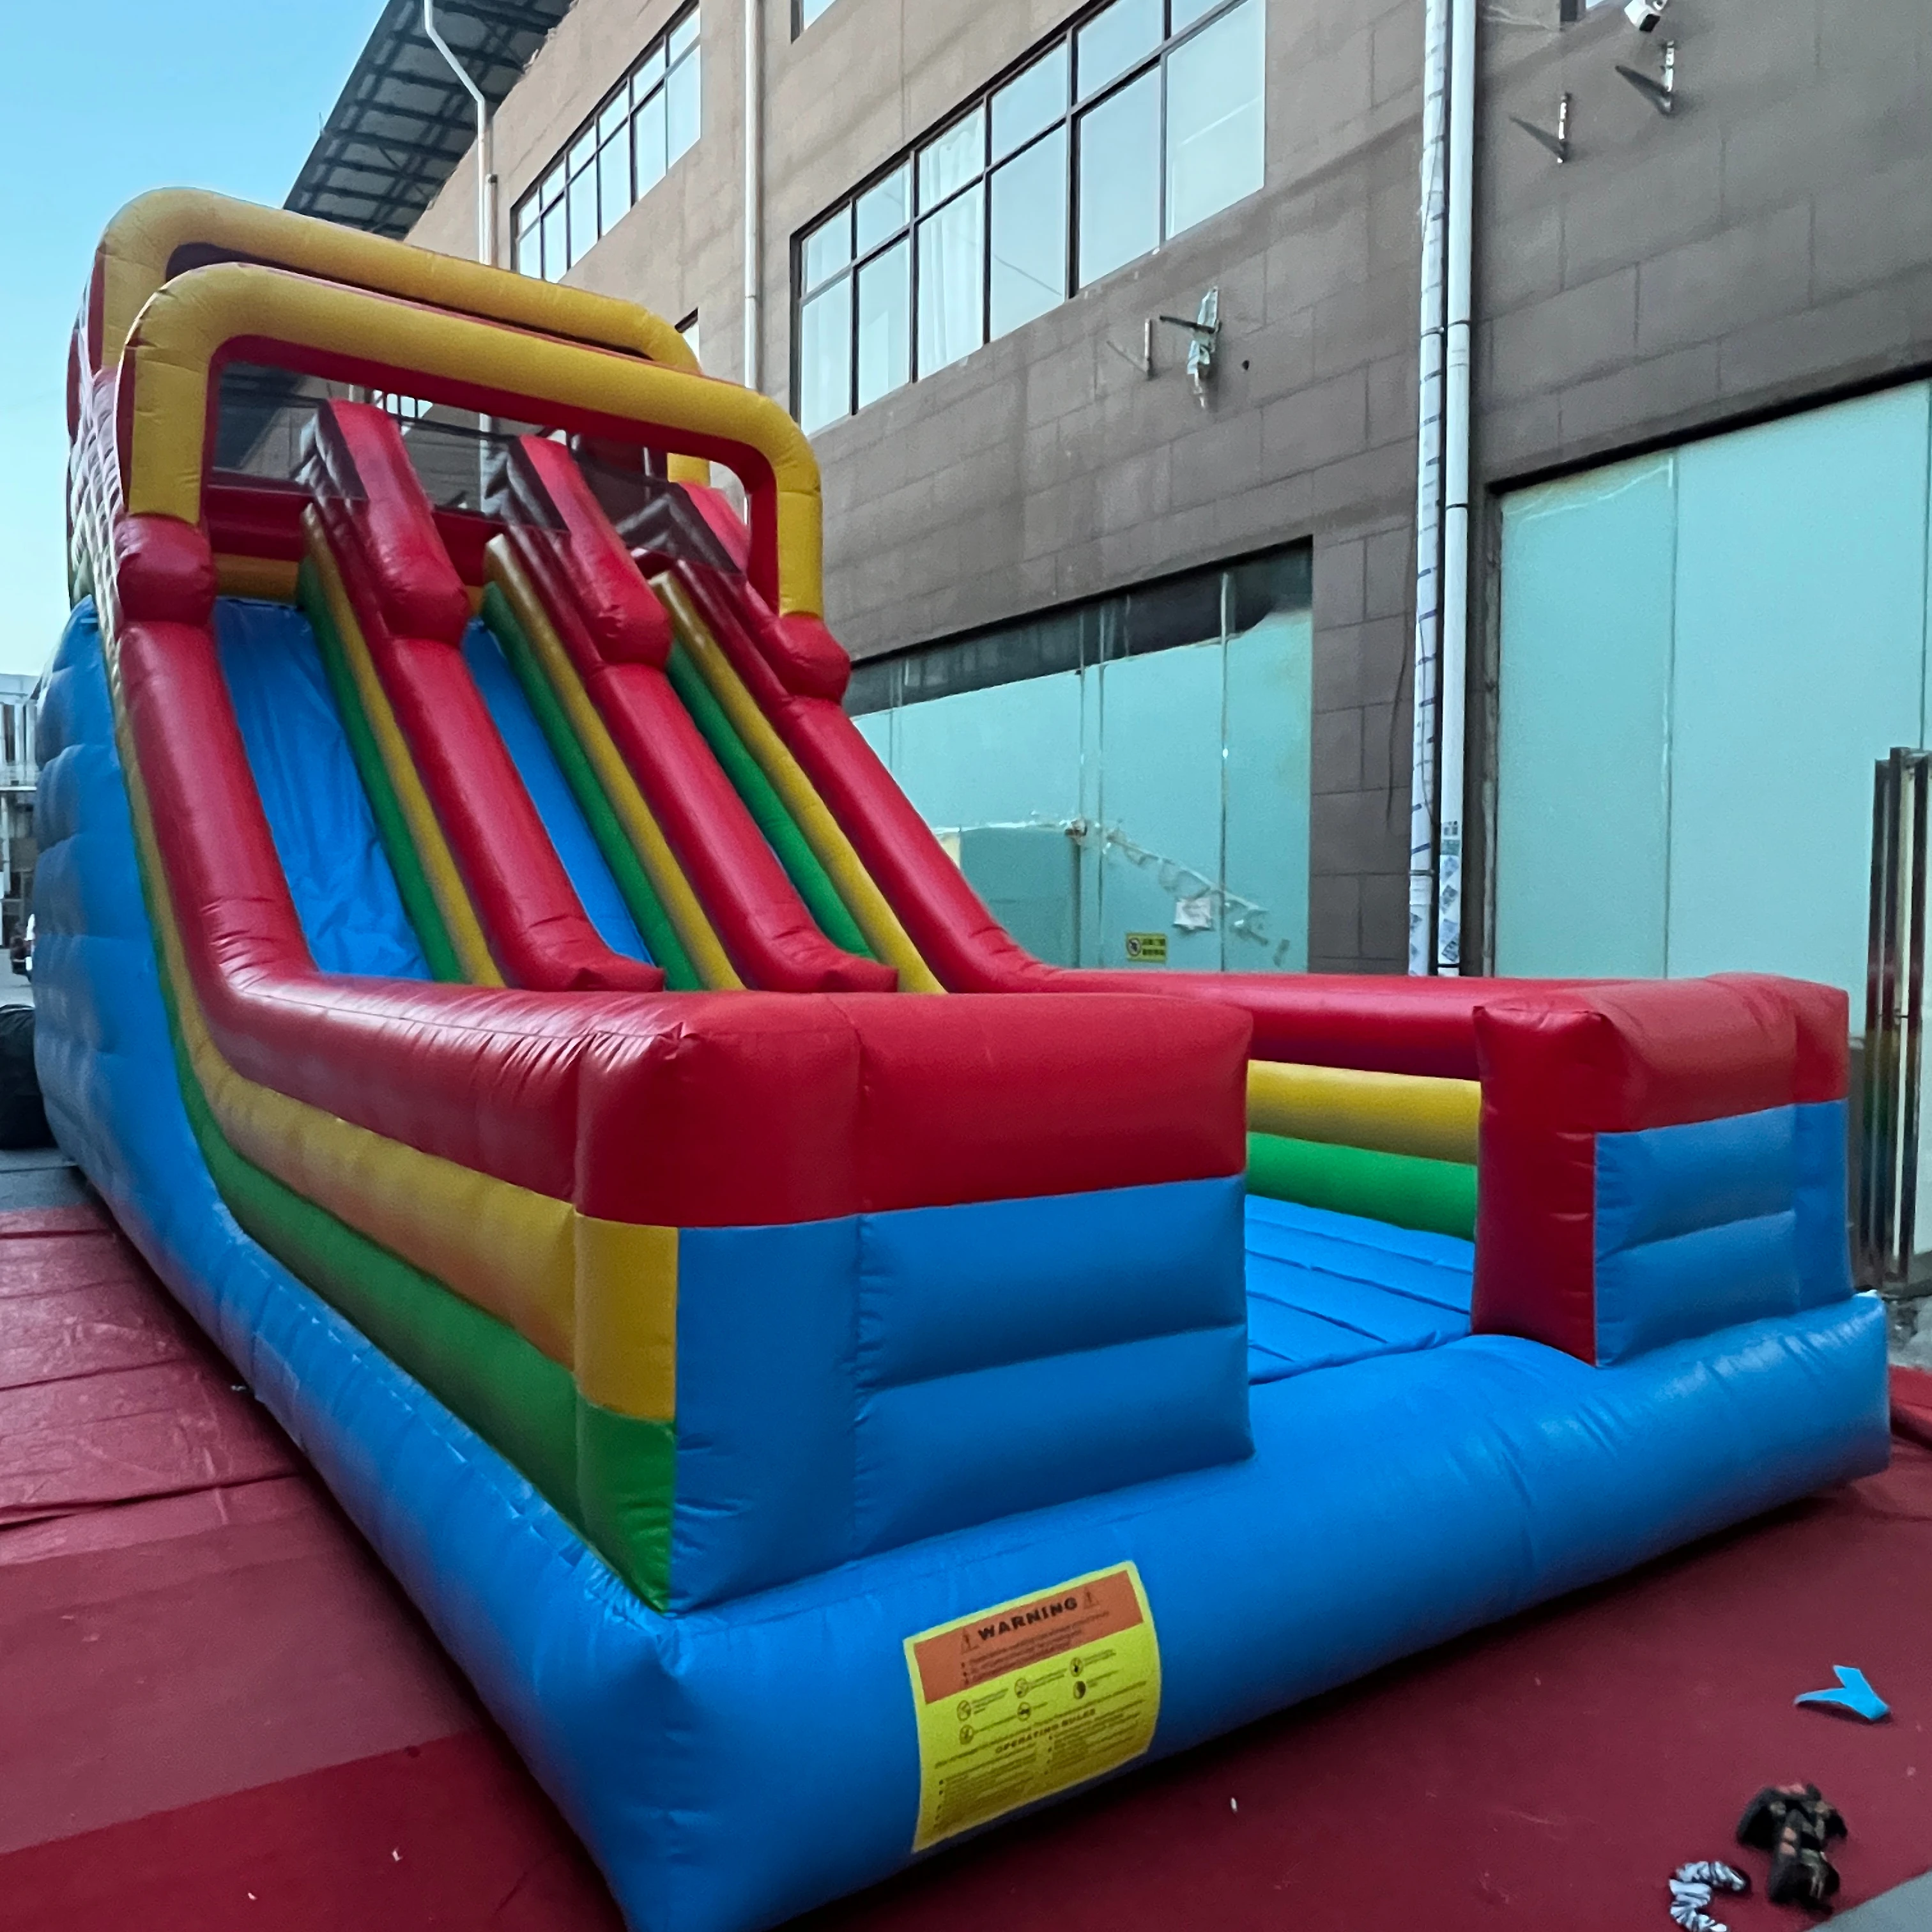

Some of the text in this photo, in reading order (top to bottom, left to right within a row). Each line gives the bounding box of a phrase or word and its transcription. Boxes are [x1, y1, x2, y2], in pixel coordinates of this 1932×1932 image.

[978, 1597, 1078, 1641] WARNING
[995, 1724, 1059, 1754] OPERATING
[1062, 1708, 1095, 1727] RULES
